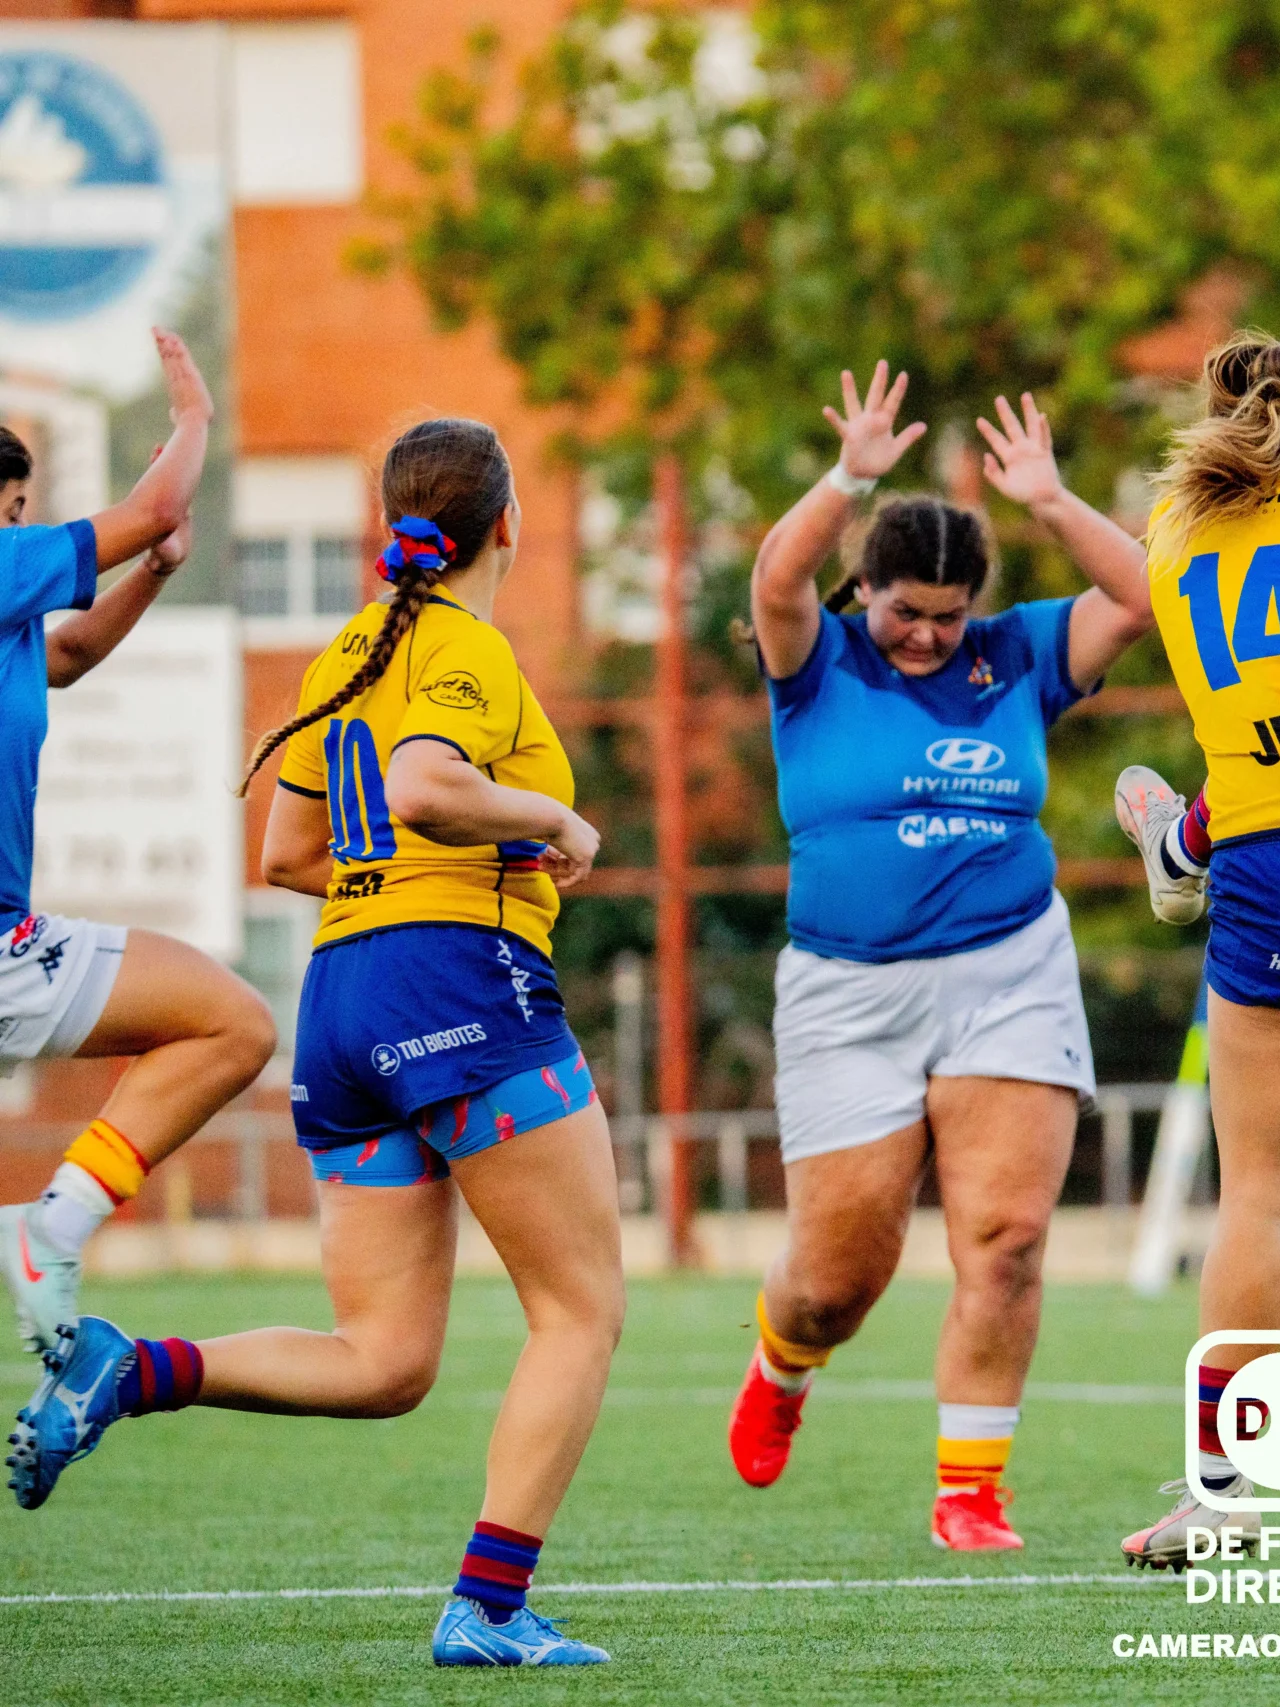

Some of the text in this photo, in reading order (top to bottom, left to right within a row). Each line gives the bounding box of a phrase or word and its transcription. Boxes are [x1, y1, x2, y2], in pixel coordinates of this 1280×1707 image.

[323, 718, 398, 865] 10
[902, 775, 1020, 794] HYUNDAI
[396, 1023, 487, 1060] TIO BIGOTES
